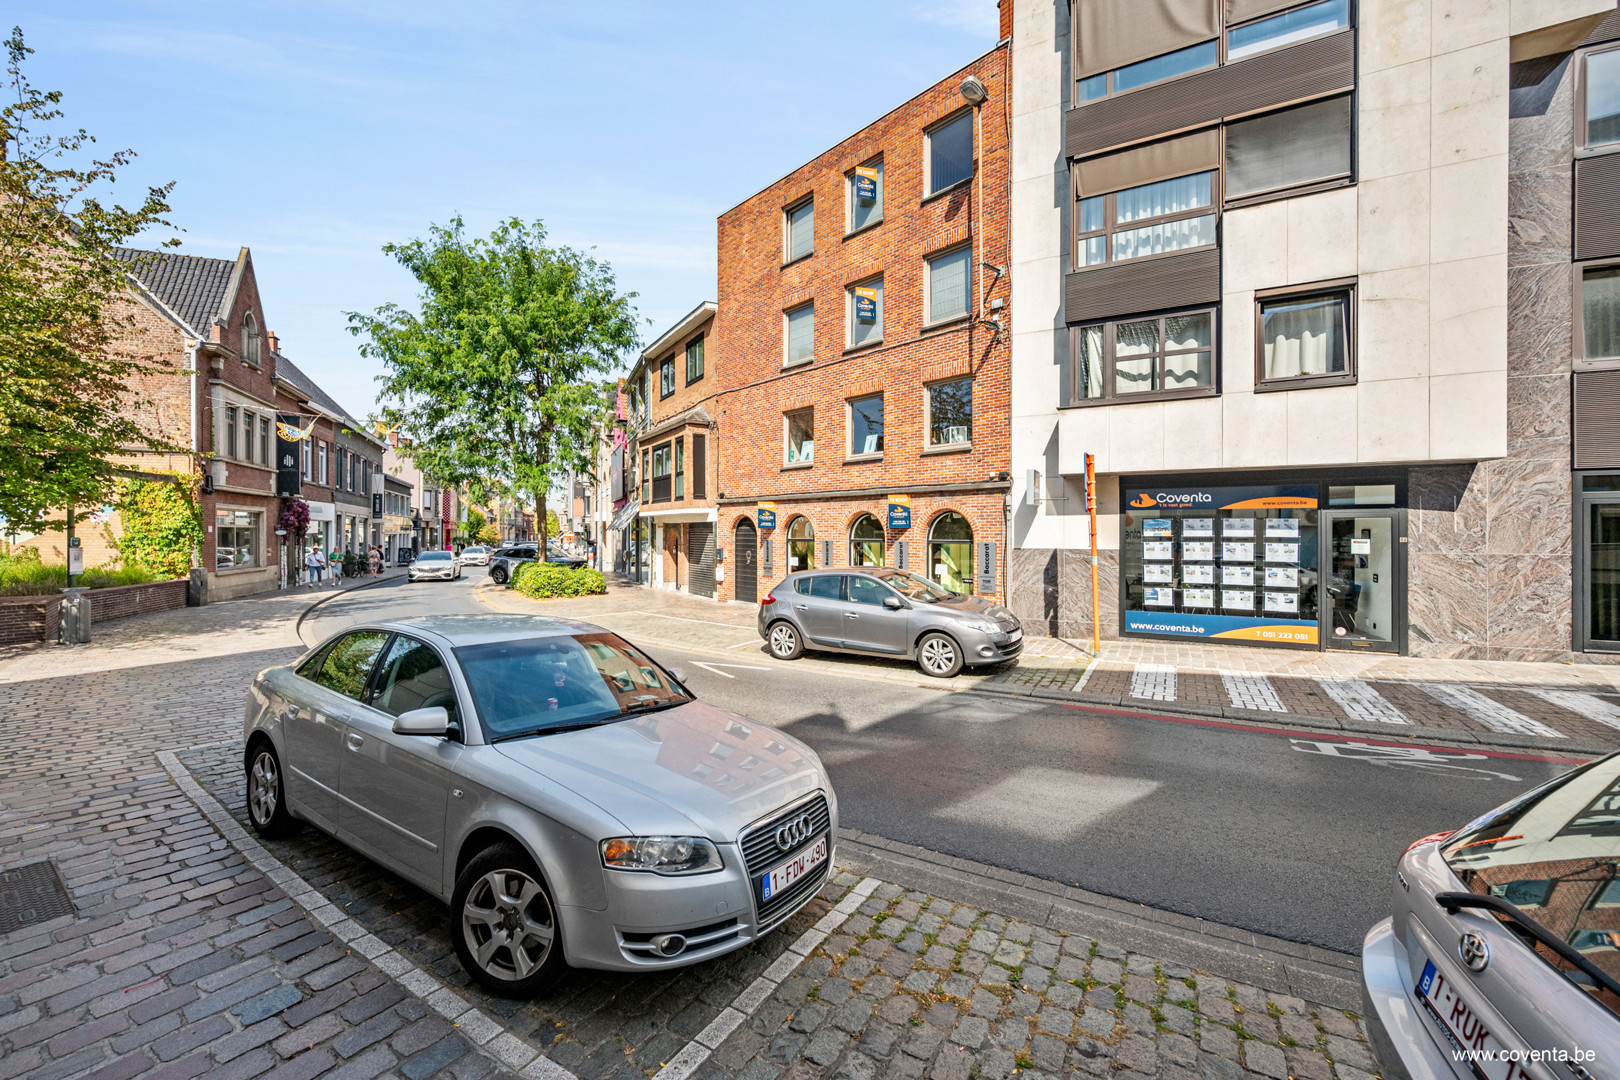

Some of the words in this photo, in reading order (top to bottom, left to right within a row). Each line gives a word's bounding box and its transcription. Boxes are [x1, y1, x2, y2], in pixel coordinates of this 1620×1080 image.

[1156, 492, 1212, 503] Coventa
[1130, 622, 1205, 634] www.coventa.be
[764, 888, 770, 897] B
[772, 840, 826, 890] 1-FDW-490
